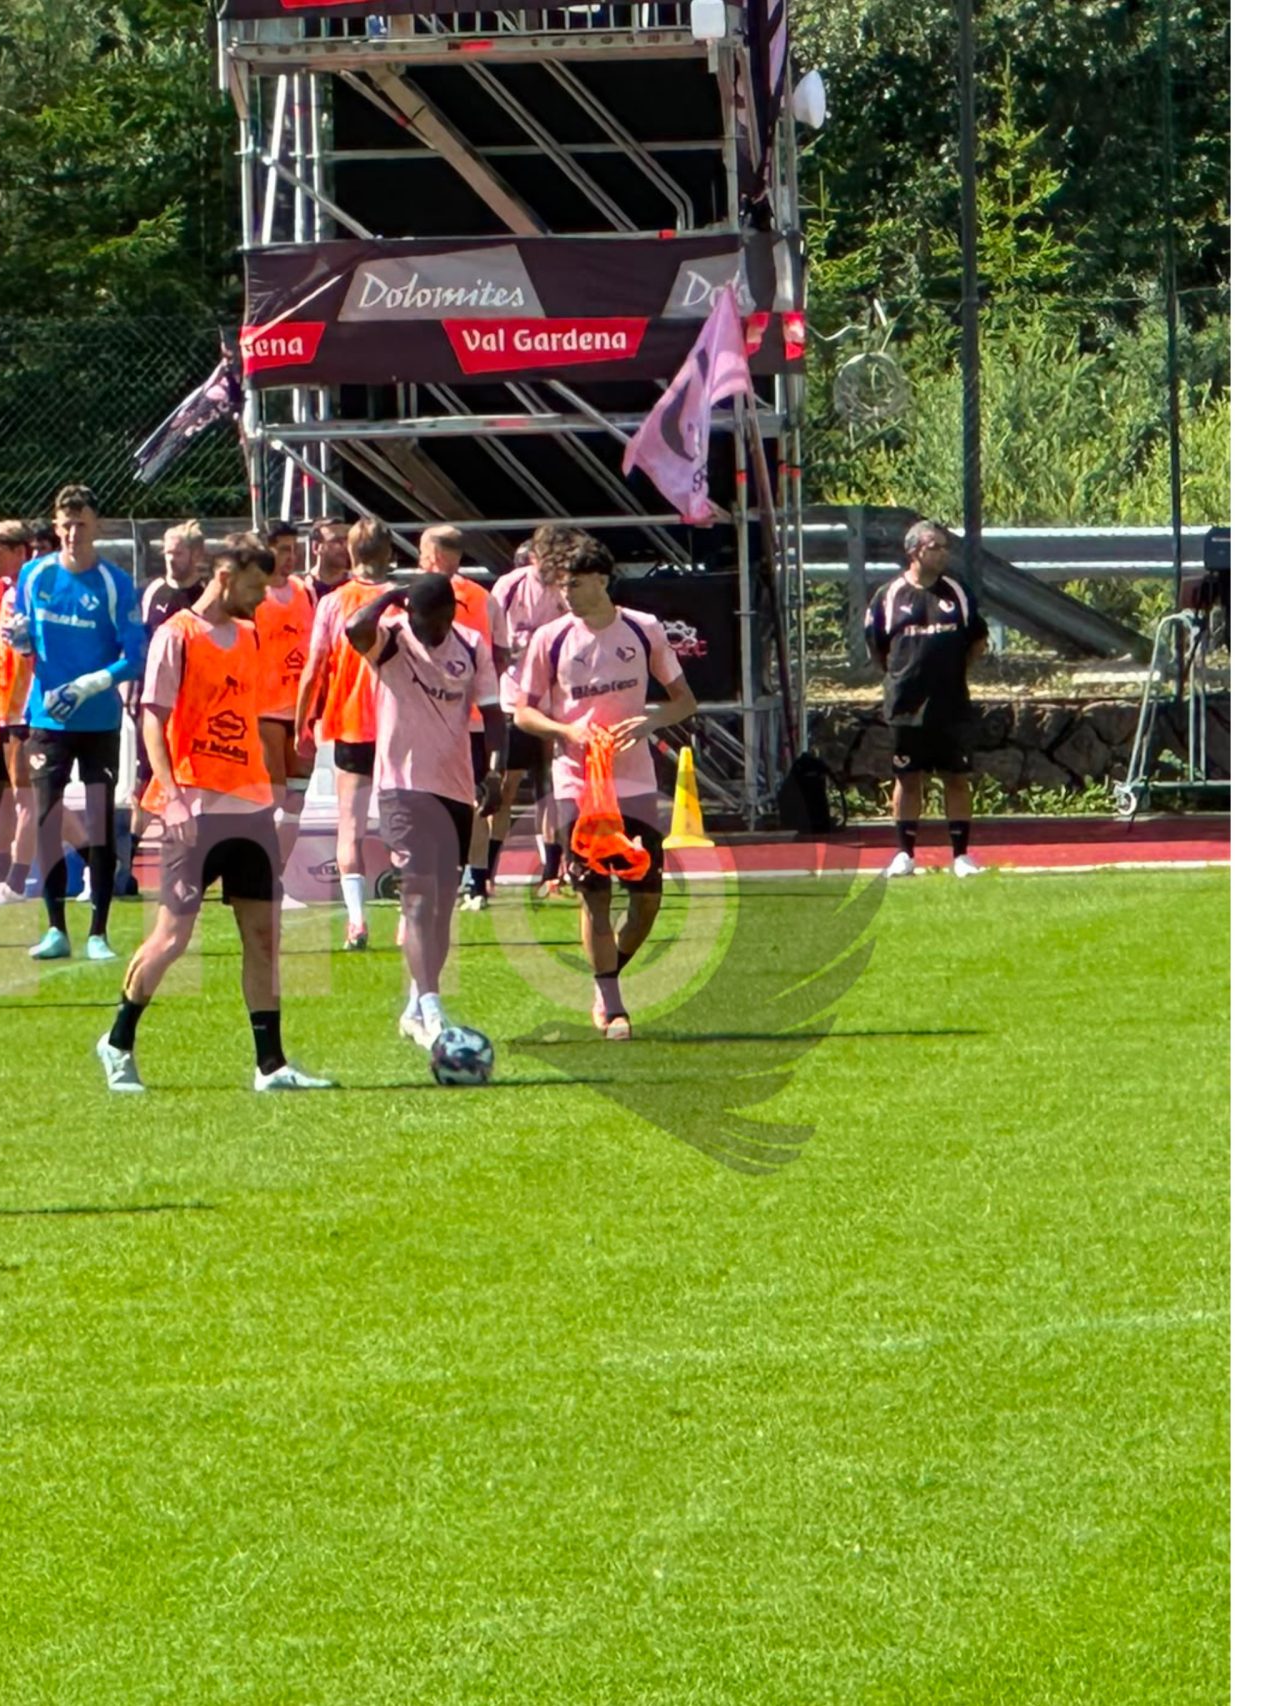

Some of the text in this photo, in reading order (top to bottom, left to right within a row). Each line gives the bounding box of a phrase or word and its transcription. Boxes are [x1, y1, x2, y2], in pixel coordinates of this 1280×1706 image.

[359, 272, 525, 309] Dolomites
[461, 327, 627, 352] Val Gardena
